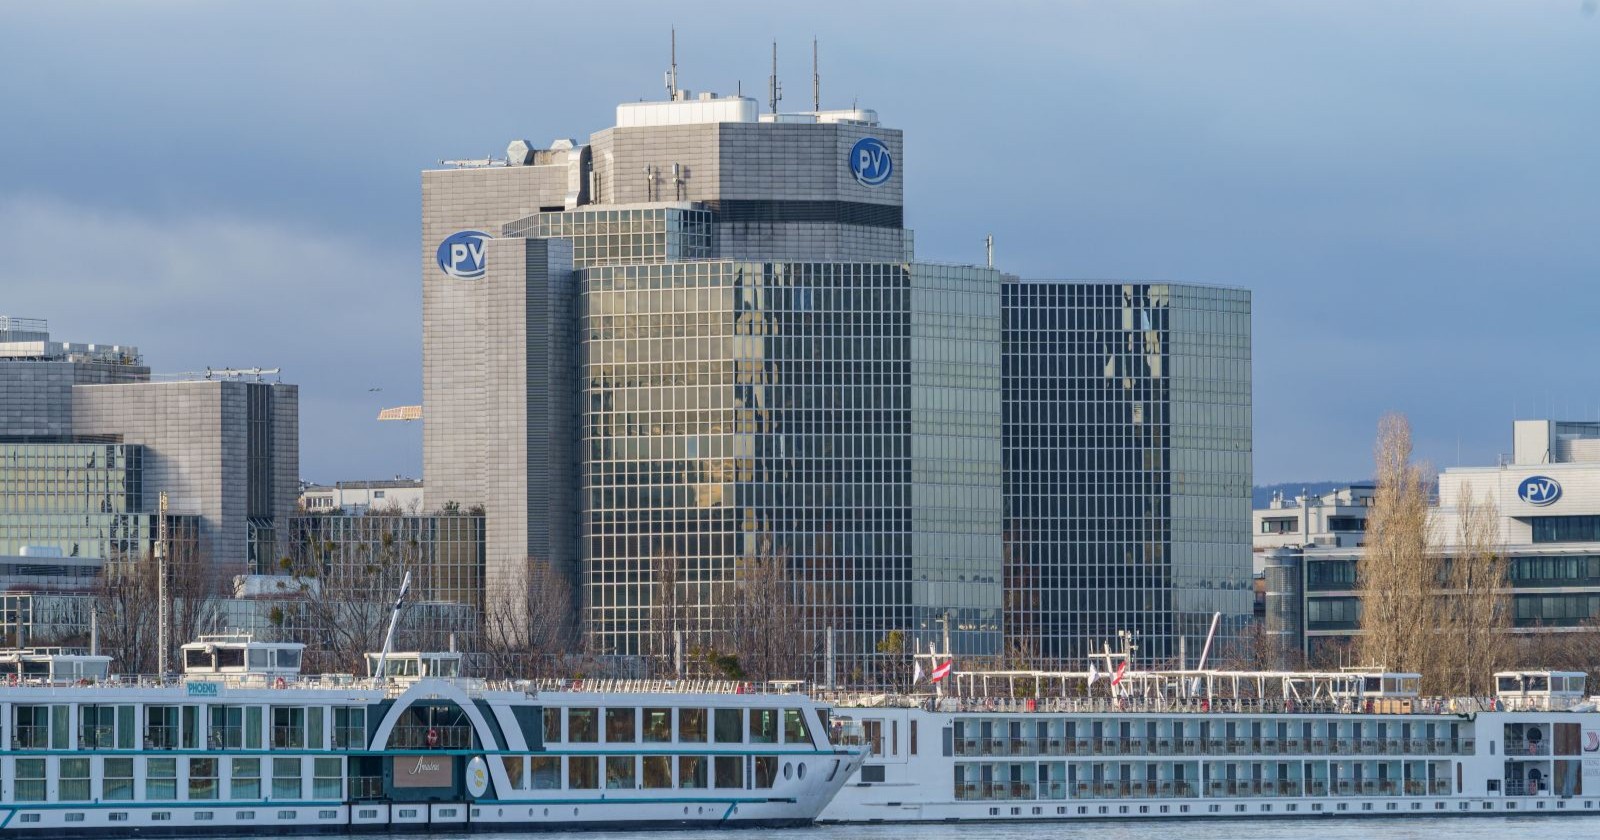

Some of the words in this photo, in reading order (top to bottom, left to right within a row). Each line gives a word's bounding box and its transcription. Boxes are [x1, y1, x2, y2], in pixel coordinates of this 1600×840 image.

[859, 148, 885, 177] PV
[451, 241, 487, 271] PV
[1527, 482, 1551, 501] PV
[188, 682, 217, 693] PHOENIX
